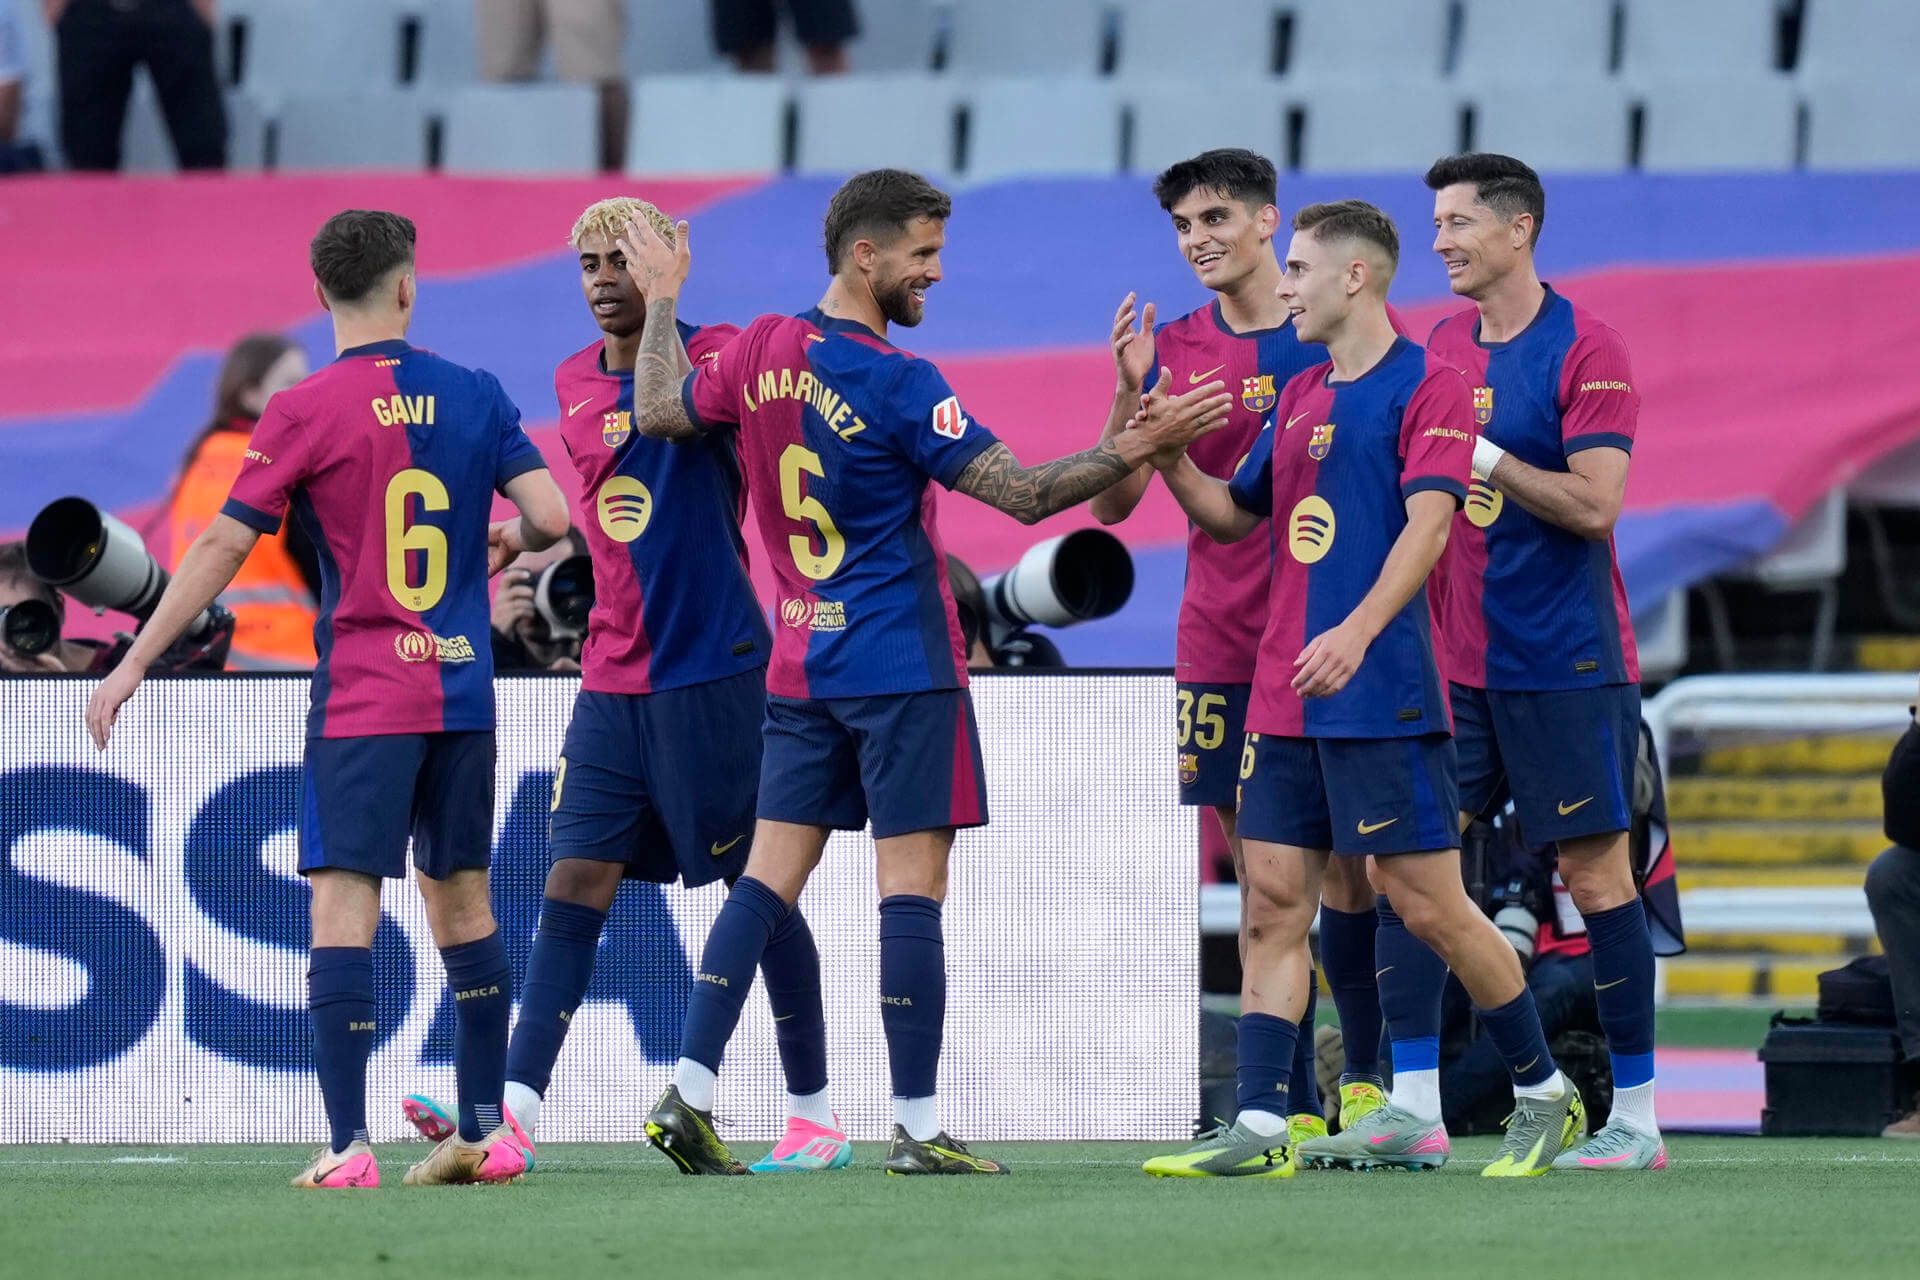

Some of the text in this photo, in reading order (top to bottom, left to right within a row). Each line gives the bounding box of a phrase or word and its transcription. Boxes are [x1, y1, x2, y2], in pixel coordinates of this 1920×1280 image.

[371, 394, 435, 427] GAVI
[758, 368, 867, 443] MARTINEZ
[1580, 380, 1627, 392] AMBILIGHT
[1422, 427, 1469, 442] AMBILIGHT
[384, 468, 450, 612] 6
[778, 443, 846, 580] 5
[1177, 689, 1228, 750] 35
